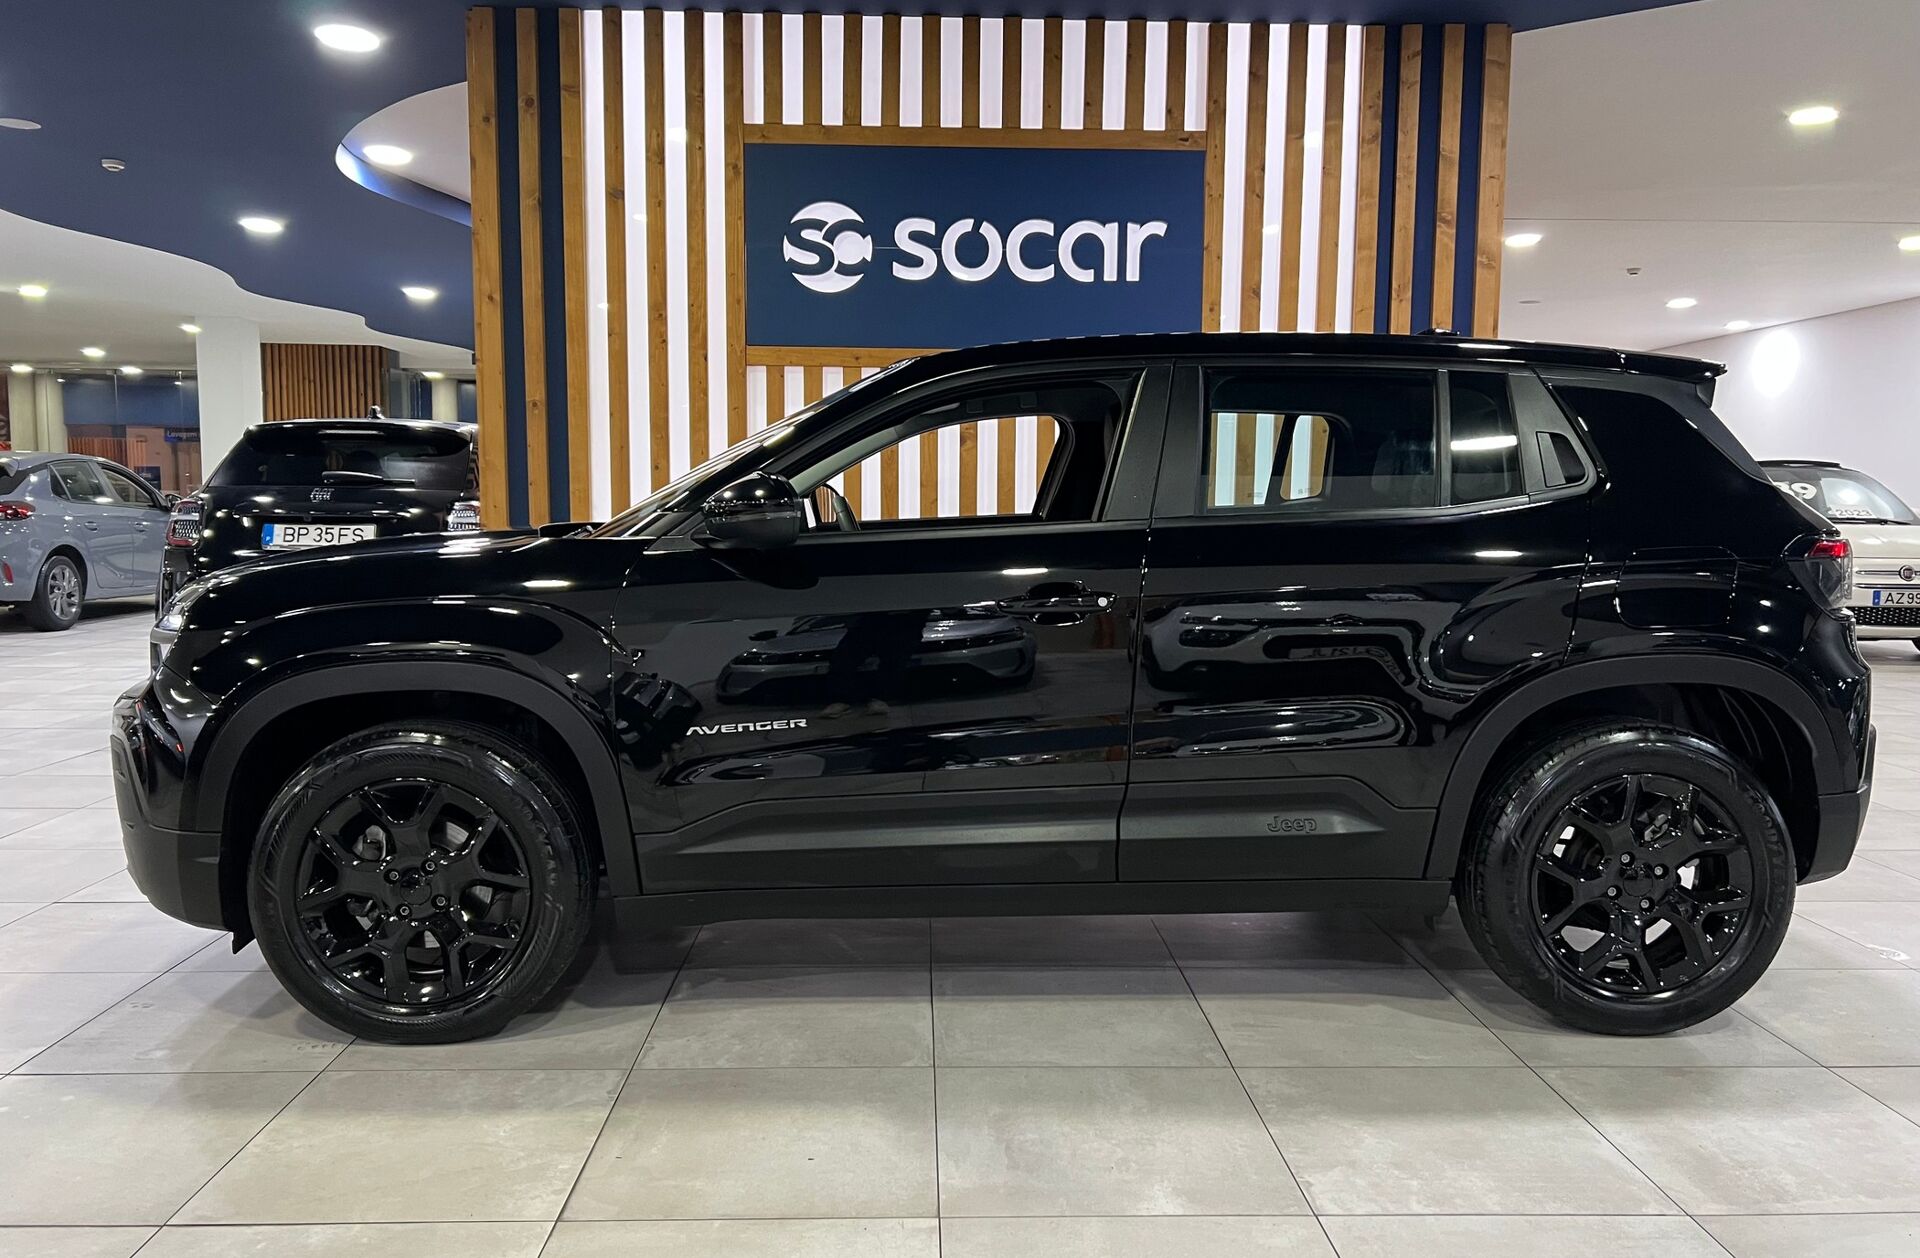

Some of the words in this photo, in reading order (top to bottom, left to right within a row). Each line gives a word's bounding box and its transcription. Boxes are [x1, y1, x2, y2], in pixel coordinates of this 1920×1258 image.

[1835, 509, 1873, 517] 2023
[283, 526, 310, 543] BP
[313, 526, 335, 543] 35
[338, 527, 365, 544] FS
[1884, 592, 1906, 605] AZ
[686, 718, 808, 736] AVENGER
[1267, 816, 1317, 834] Jeep
